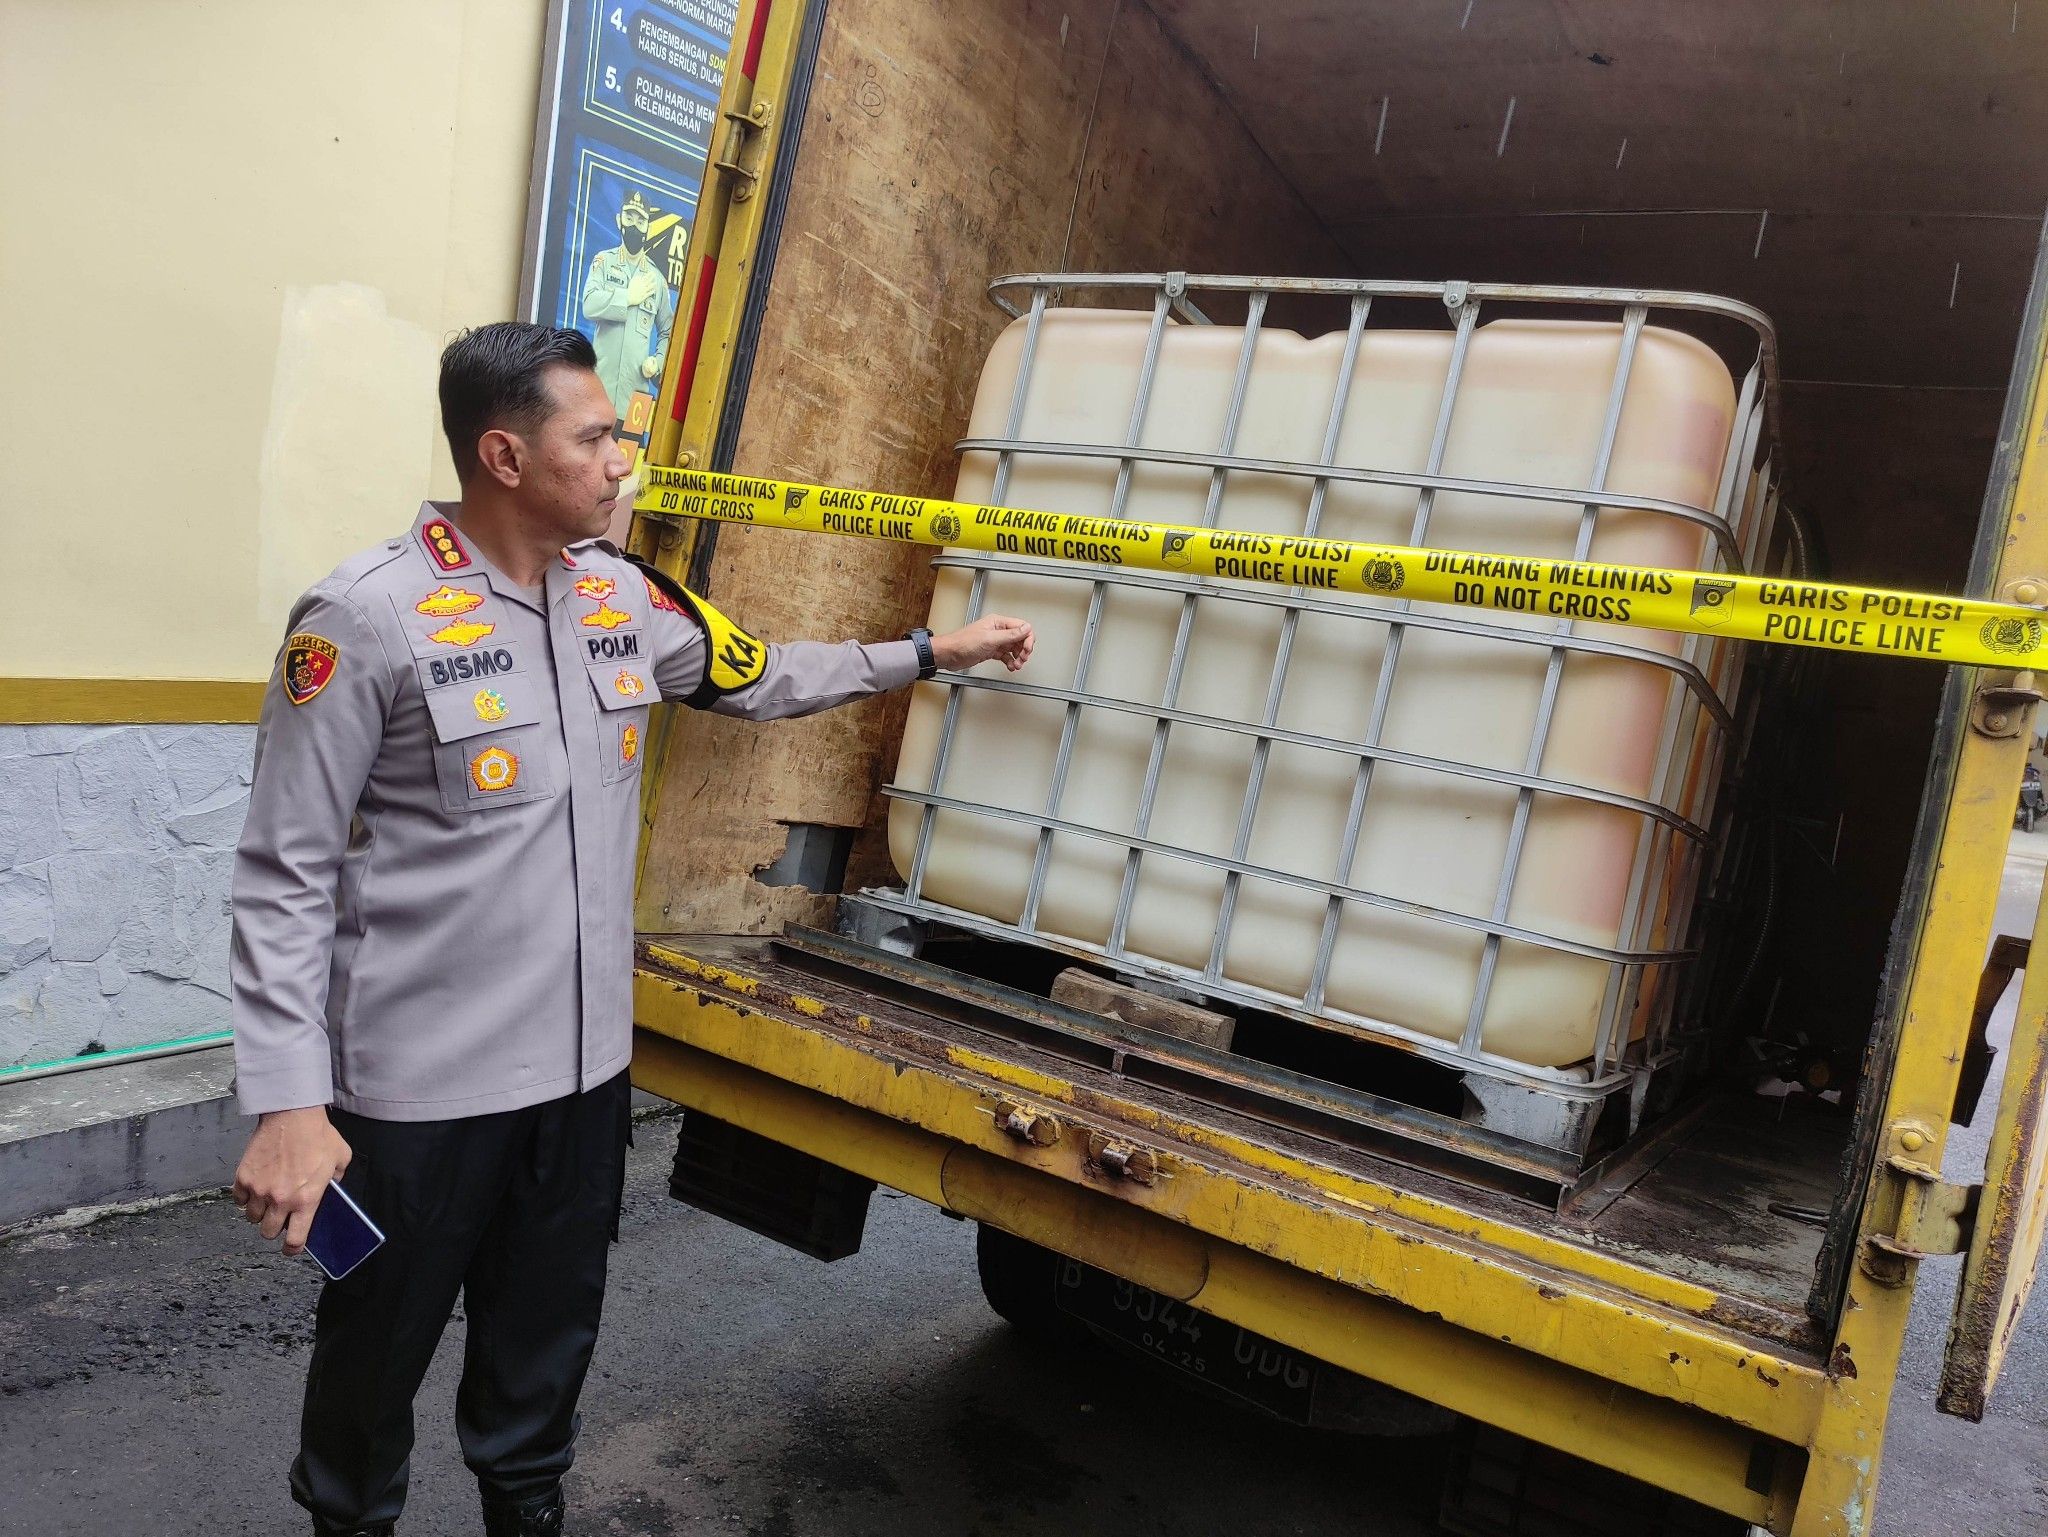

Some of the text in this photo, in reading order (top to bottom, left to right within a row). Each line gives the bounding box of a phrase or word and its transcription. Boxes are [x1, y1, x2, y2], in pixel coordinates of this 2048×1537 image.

[706, 12, 735, 37] MARTA
[639, 19, 726, 72] PENGEMBANGAN SDM
[639, 36, 723, 87] HARUS SERIUS, DILAK
[635, 93, 701, 134] KELEMBAGAAN
[637, 76, 715, 124] POLRI HARUS MEM
[711, 473, 777, 500] MELINTAS
[819, 490, 925, 518] GARIS POLISI
[660, 492, 754, 521] DO NOT CROSS
[823, 513, 914, 540] POLICE LINE
[975, 507, 1151, 542] DILARANG MELINTAS
[997, 533, 1123, 564] DO NOT CROSS
[1209, 531, 1352, 563] GARIS POLISI
[1215, 557, 1338, 588] POLICE LINE
[1425, 551, 1674, 595] DILARANG MELINTAS
[1453, 582, 1632, 622] DO NOT CROSS
[1758, 582, 1964, 622] GARIS POLISI
[293, 637, 336, 658] RESERSE
[587, 634, 639, 660] POLRI
[1765, 614, 1946, 653] POLICE LINE
[430, 648, 514, 685] BISMO
[718, 632, 759, 679] KA
